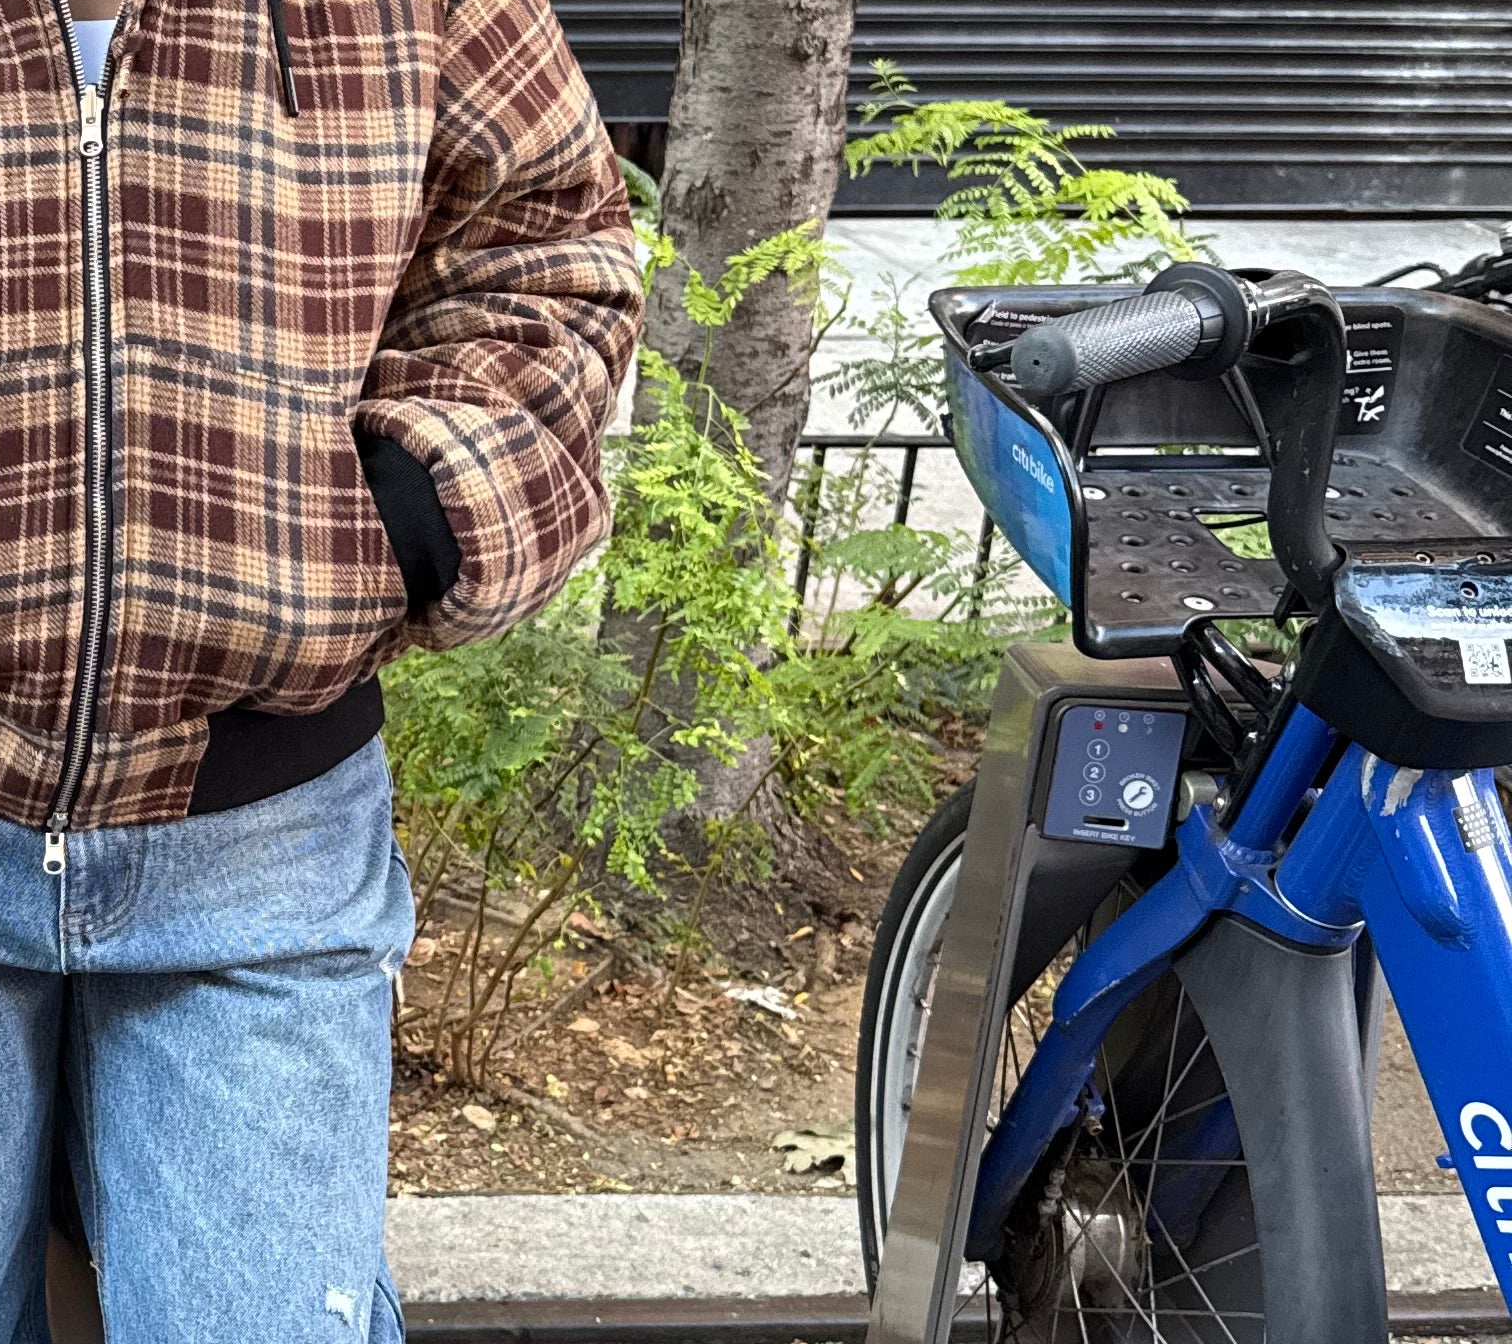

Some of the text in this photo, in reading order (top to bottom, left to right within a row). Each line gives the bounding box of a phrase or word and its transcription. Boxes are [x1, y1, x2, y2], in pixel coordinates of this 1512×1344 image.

[1030, 454, 1055, 493] bike
[1462, 606, 1477, 617] to
[1094, 744, 1101, 755] 1
[1089, 766, 1099, 779] 2
[1085, 789, 1095, 801] 3
[1072, 828, 1100, 839] INSERT
[1119, 833, 1136, 843] KEY
